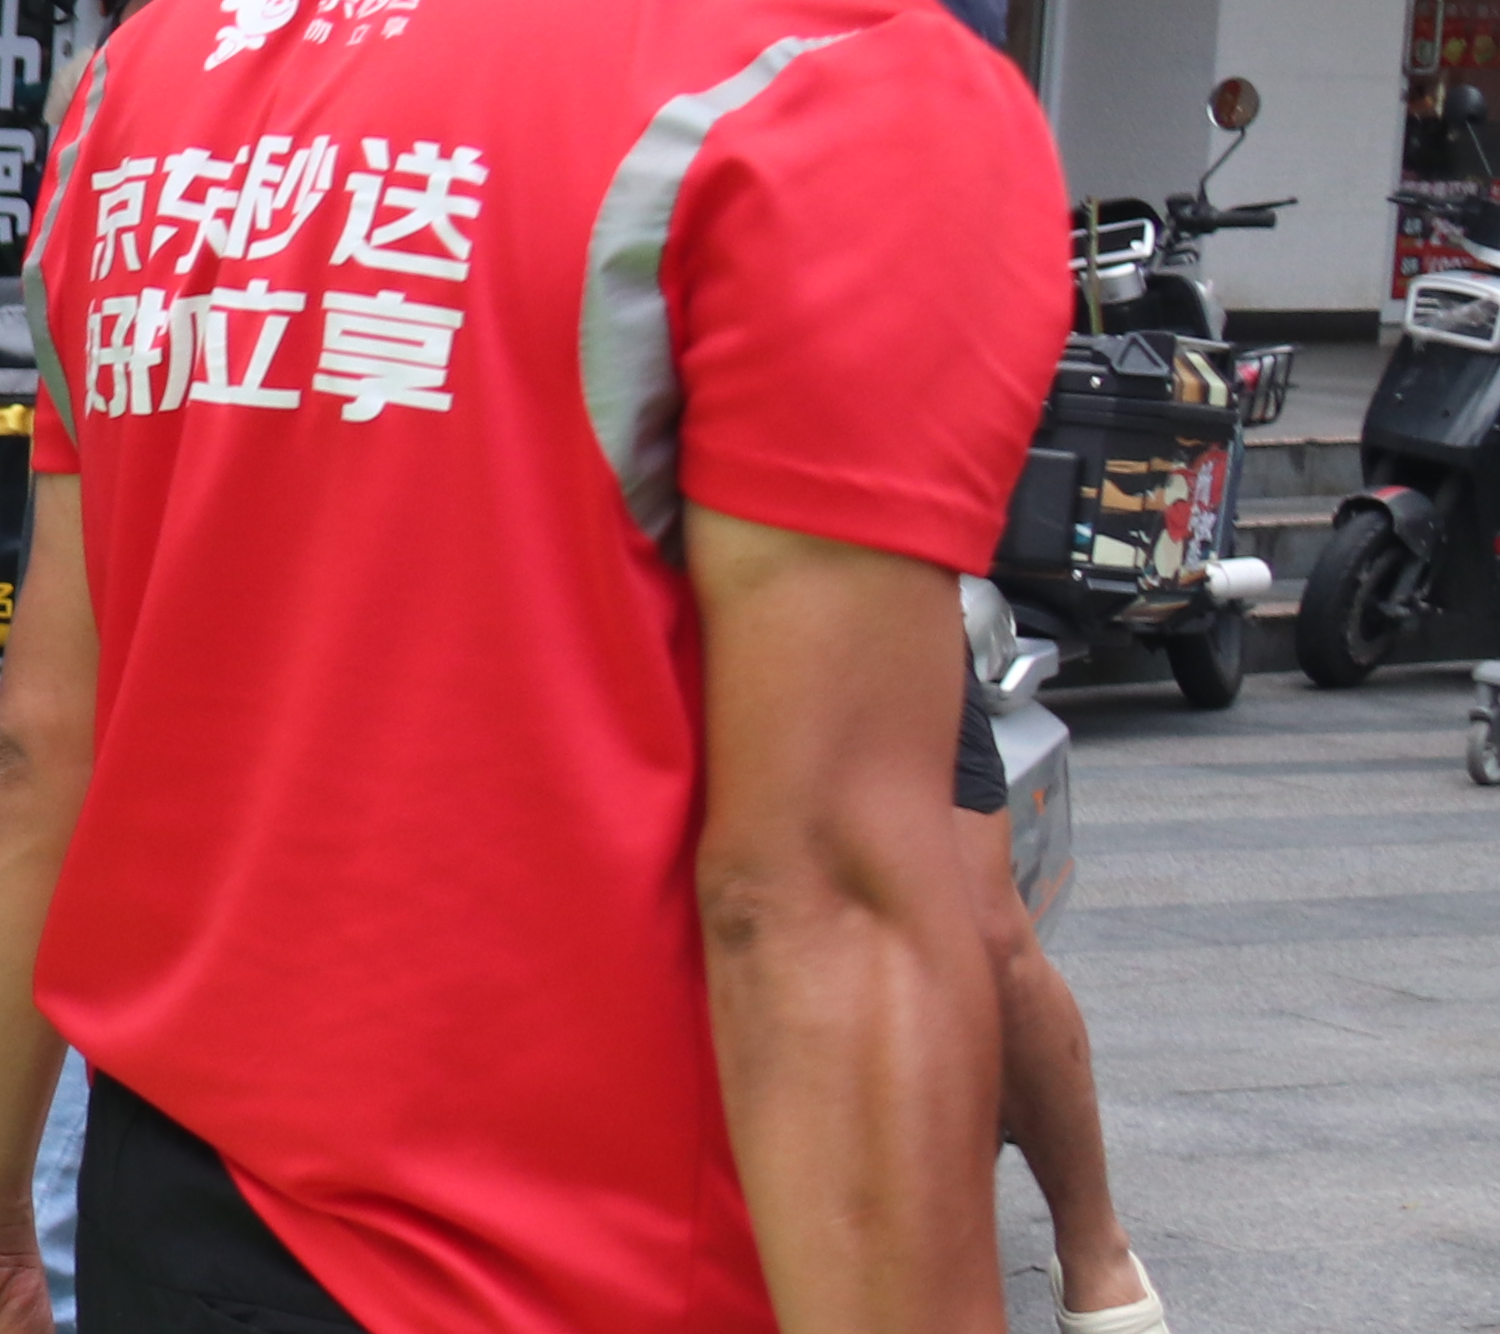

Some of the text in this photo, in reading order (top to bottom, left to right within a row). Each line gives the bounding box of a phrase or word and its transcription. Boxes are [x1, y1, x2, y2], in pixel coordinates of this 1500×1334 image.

[89, 134, 490, 283] 京东秒送
[84, 279, 466, 423] 好物立享
